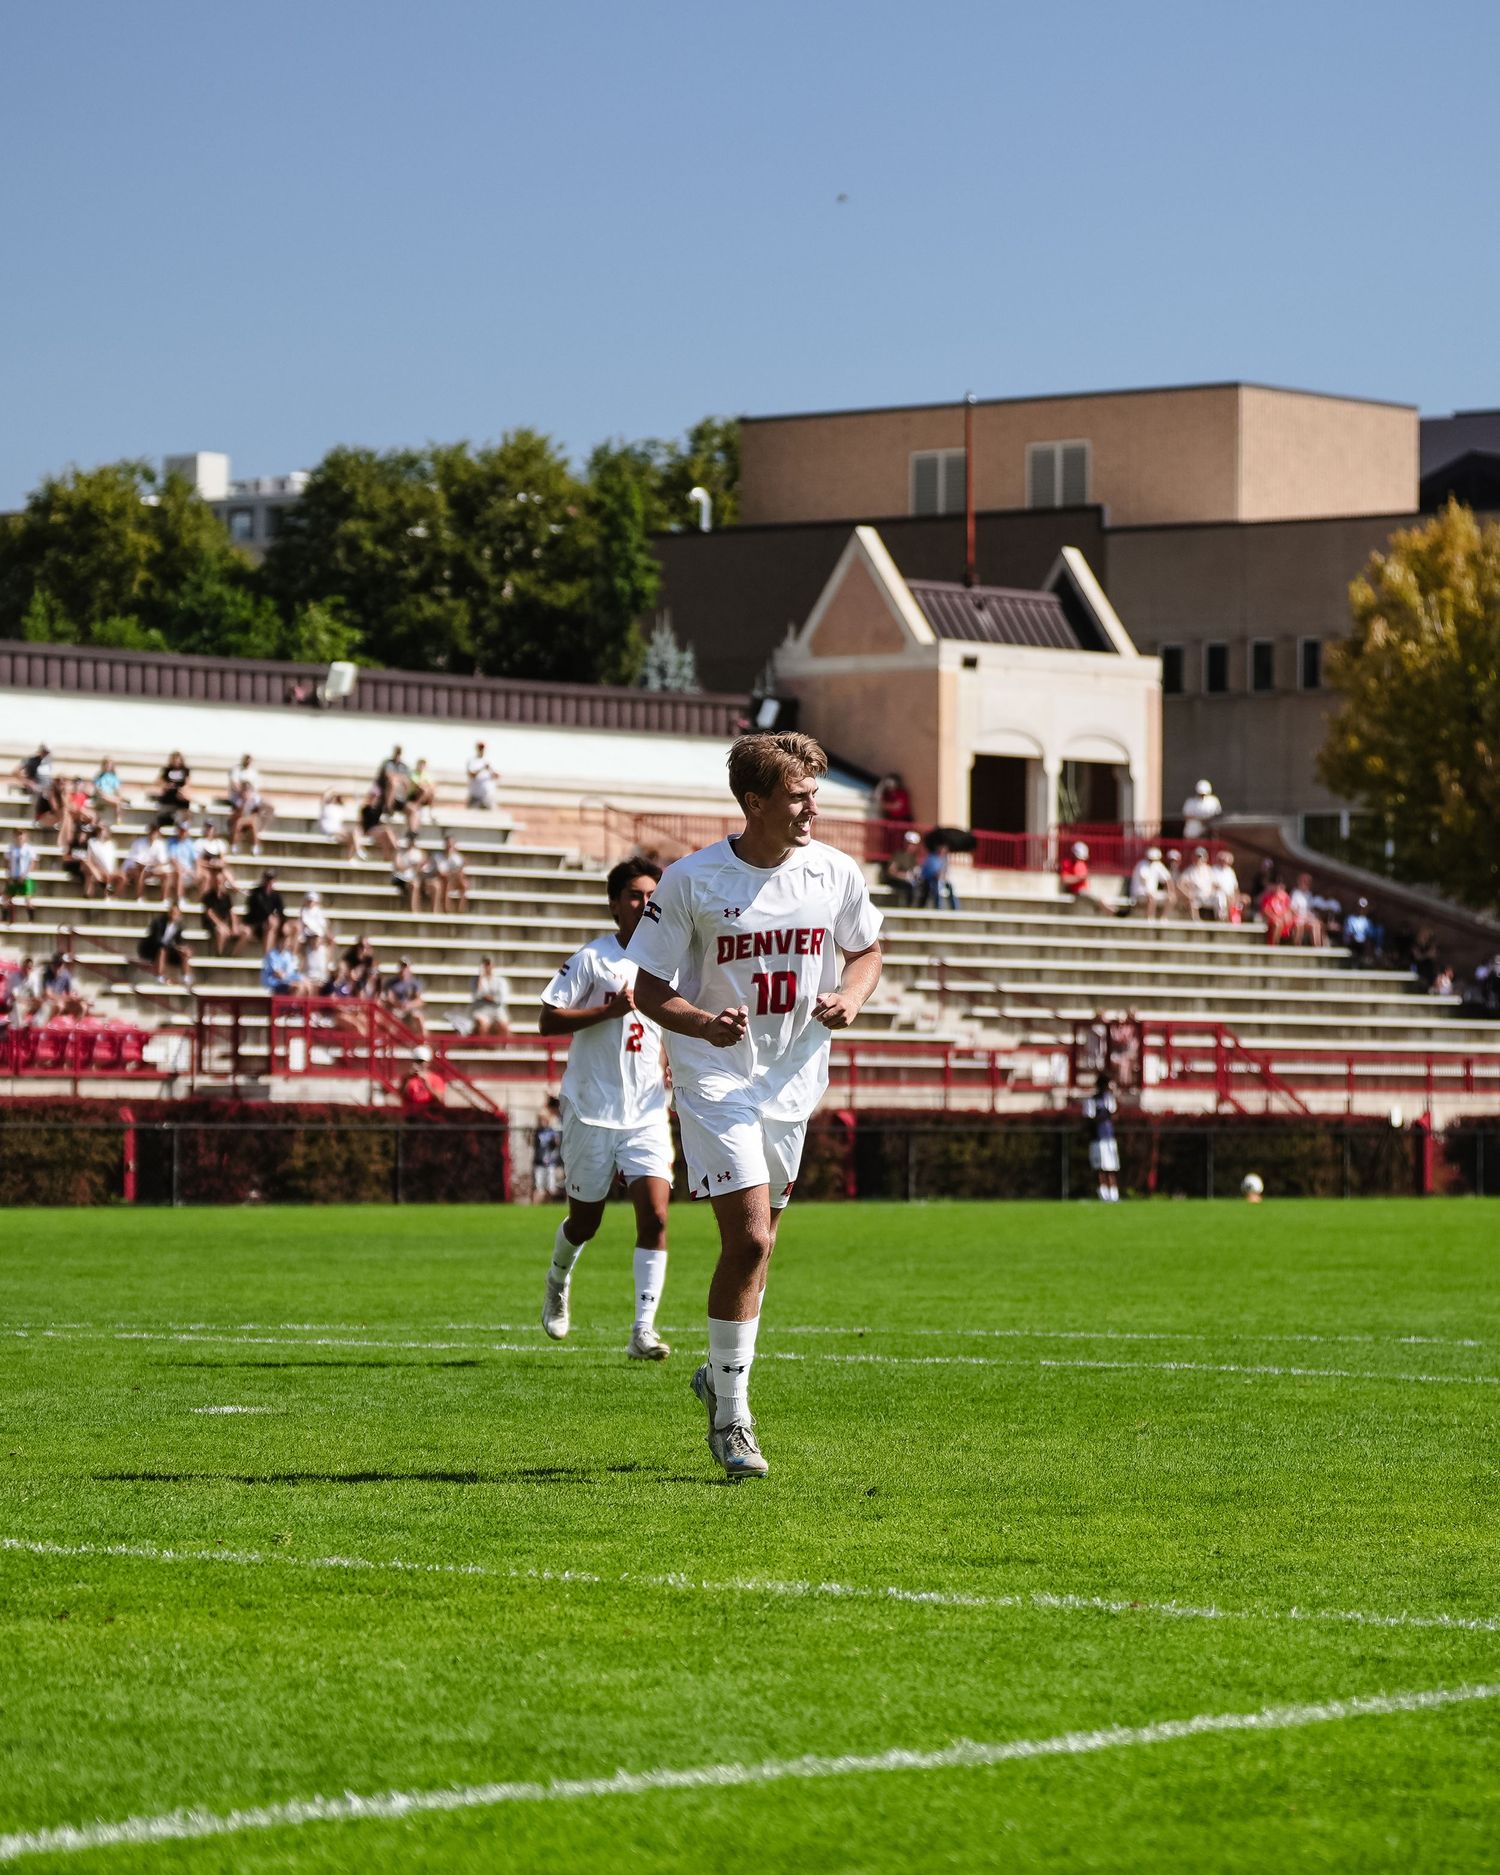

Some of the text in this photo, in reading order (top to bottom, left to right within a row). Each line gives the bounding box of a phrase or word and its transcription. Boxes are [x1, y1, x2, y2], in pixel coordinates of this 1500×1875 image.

[717, 928, 825, 965] DENVER
[751, 971, 797, 1016] 10
[626, 1023, 645, 1052] 2
